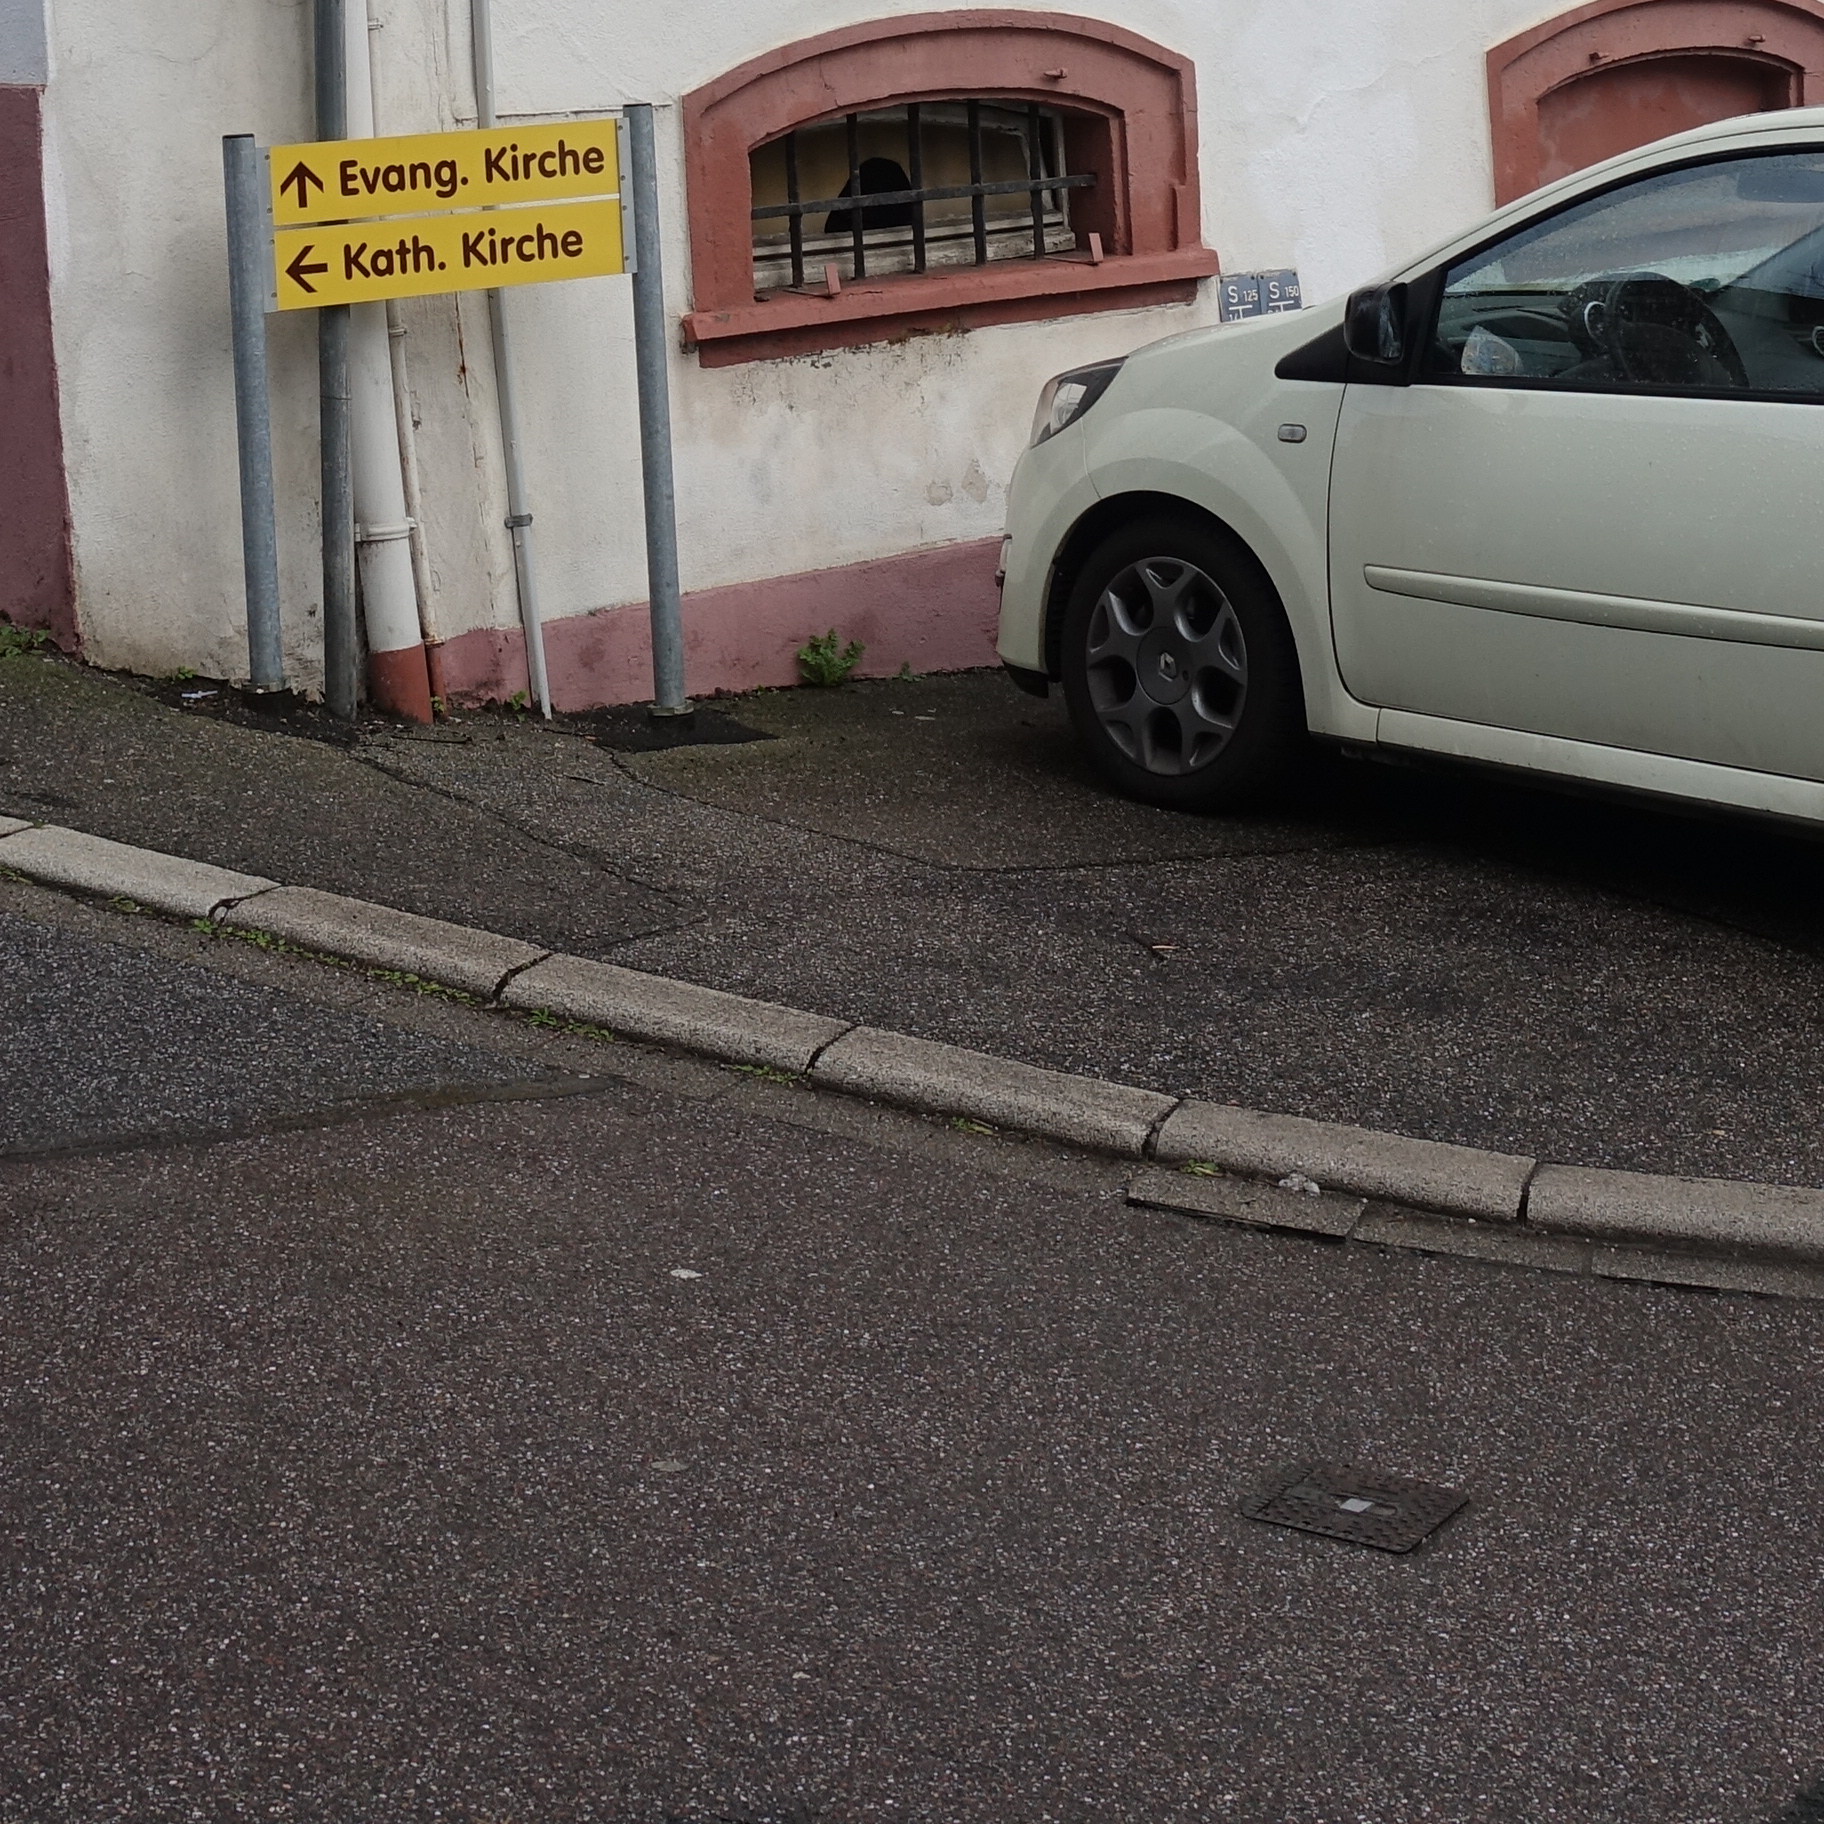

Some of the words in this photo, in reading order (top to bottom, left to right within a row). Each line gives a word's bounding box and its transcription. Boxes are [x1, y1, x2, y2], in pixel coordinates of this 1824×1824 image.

[339, 159, 470, 199] Evang.
[485, 139, 605, 184] Kirche
[343, 234, 447, 281] Kath.
[462, 222, 583, 268] Kirche
[1228, 285, 1238, 303] S
[1243, 289, 1258, 302] 125
[1269, 281, 1280, 299] S
[1284, 285, 1299, 298] 150
